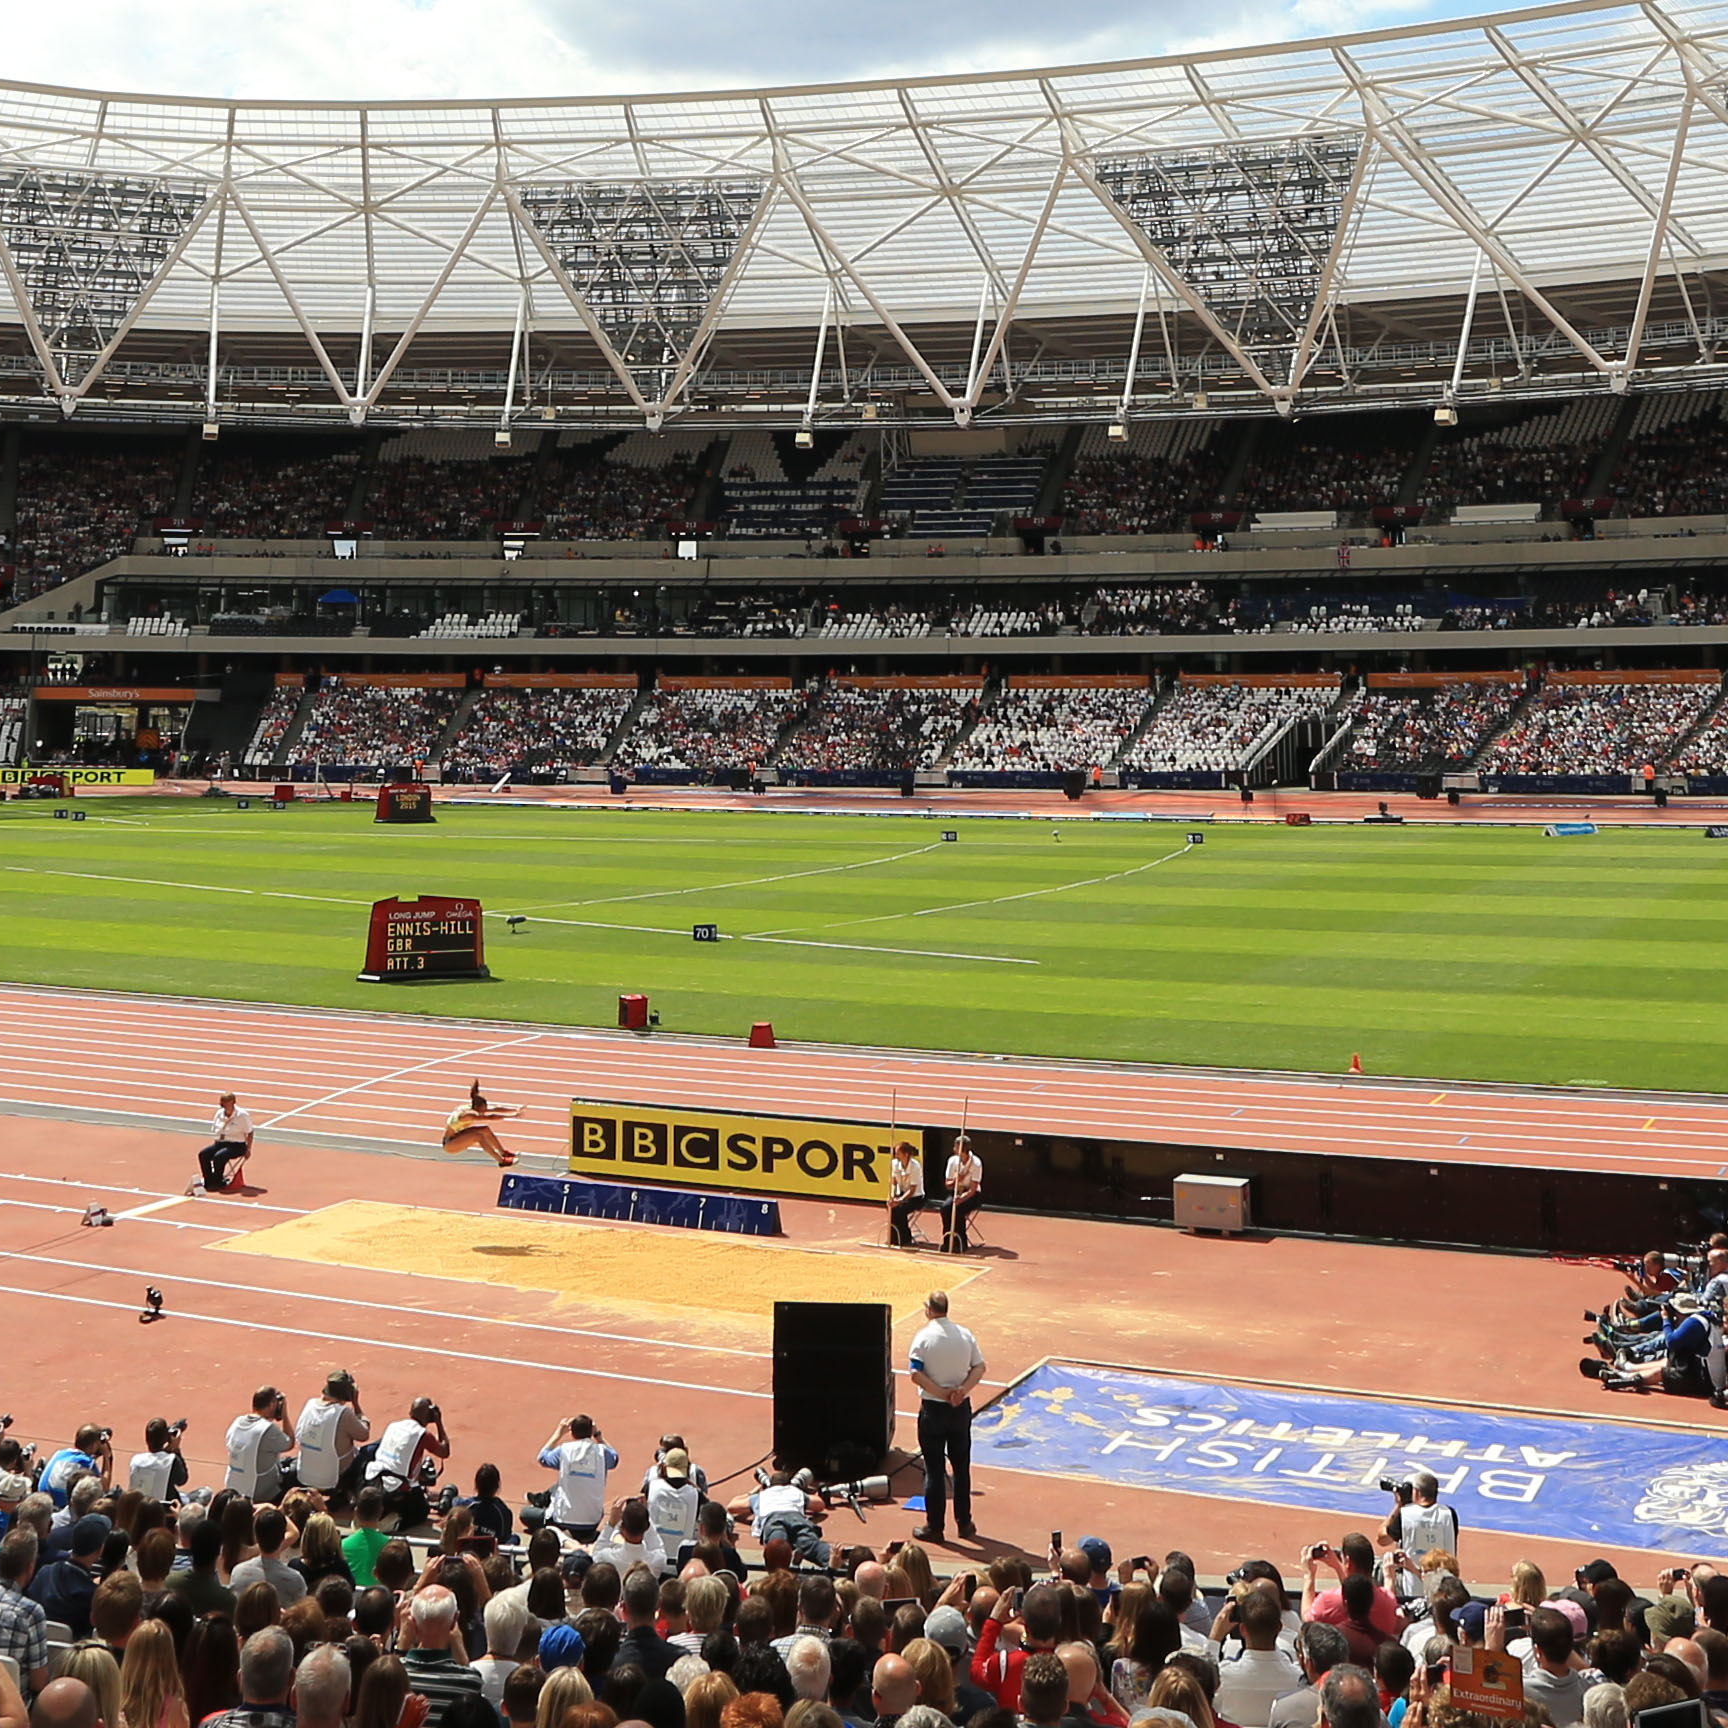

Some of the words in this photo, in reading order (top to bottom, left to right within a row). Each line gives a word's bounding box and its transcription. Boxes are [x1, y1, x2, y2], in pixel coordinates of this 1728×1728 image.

[87, 688, 140, 700] Sainsbury's
[389, 912, 411, 920] LONG
[413, 911, 436, 920] JUMP
[446, 911, 474, 919] OMEGA
[387, 920, 474, 937] ENNIS-HILL
[696, 927, 709, 939] 70
[387, 938, 412, 952] GBR
[578, 1119, 716, 1168] BBC
[507, 1177, 515, 1189] 4
[563, 1184, 570, 1194] 5
[631, 1190, 638, 1202] 6
[699, 1197, 706, 1209] 7
[761, 1203, 769, 1215] 8
[1128, 1407, 1577, 1467] ATHLETICS
[667, 1513, 678, 1522] 34
[1425, 1534, 1436, 1544] 15
[1453, 1688, 1522, 1711] Extraordinary
